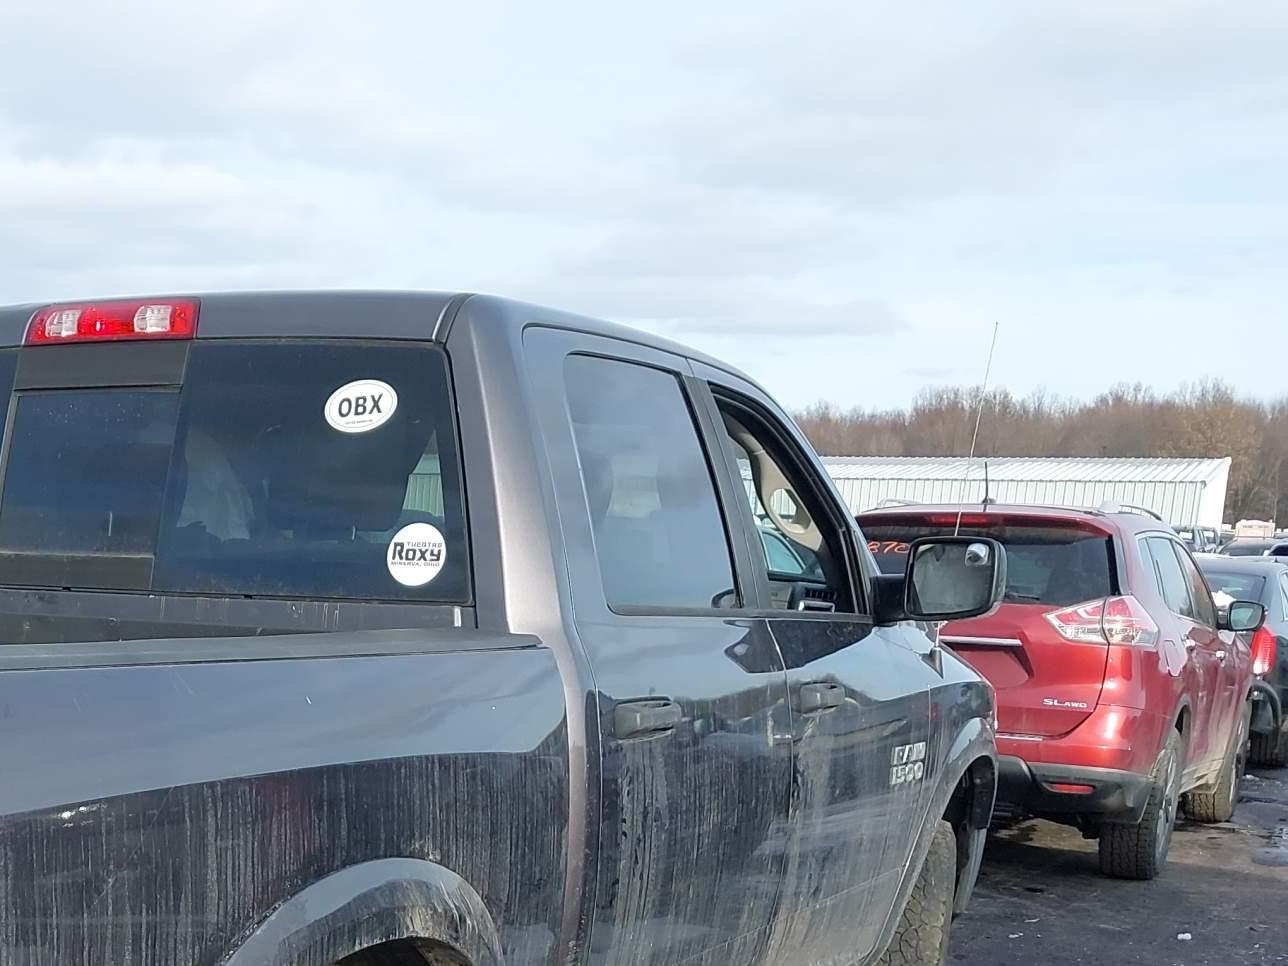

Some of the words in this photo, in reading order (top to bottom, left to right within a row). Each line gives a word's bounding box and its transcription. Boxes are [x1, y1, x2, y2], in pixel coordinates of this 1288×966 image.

[337, 393, 383, 418] OBX
[1042, 698, 1063, 706] SL
[890, 741, 926, 765] RAM
[888, 761, 923, 785] 1500
